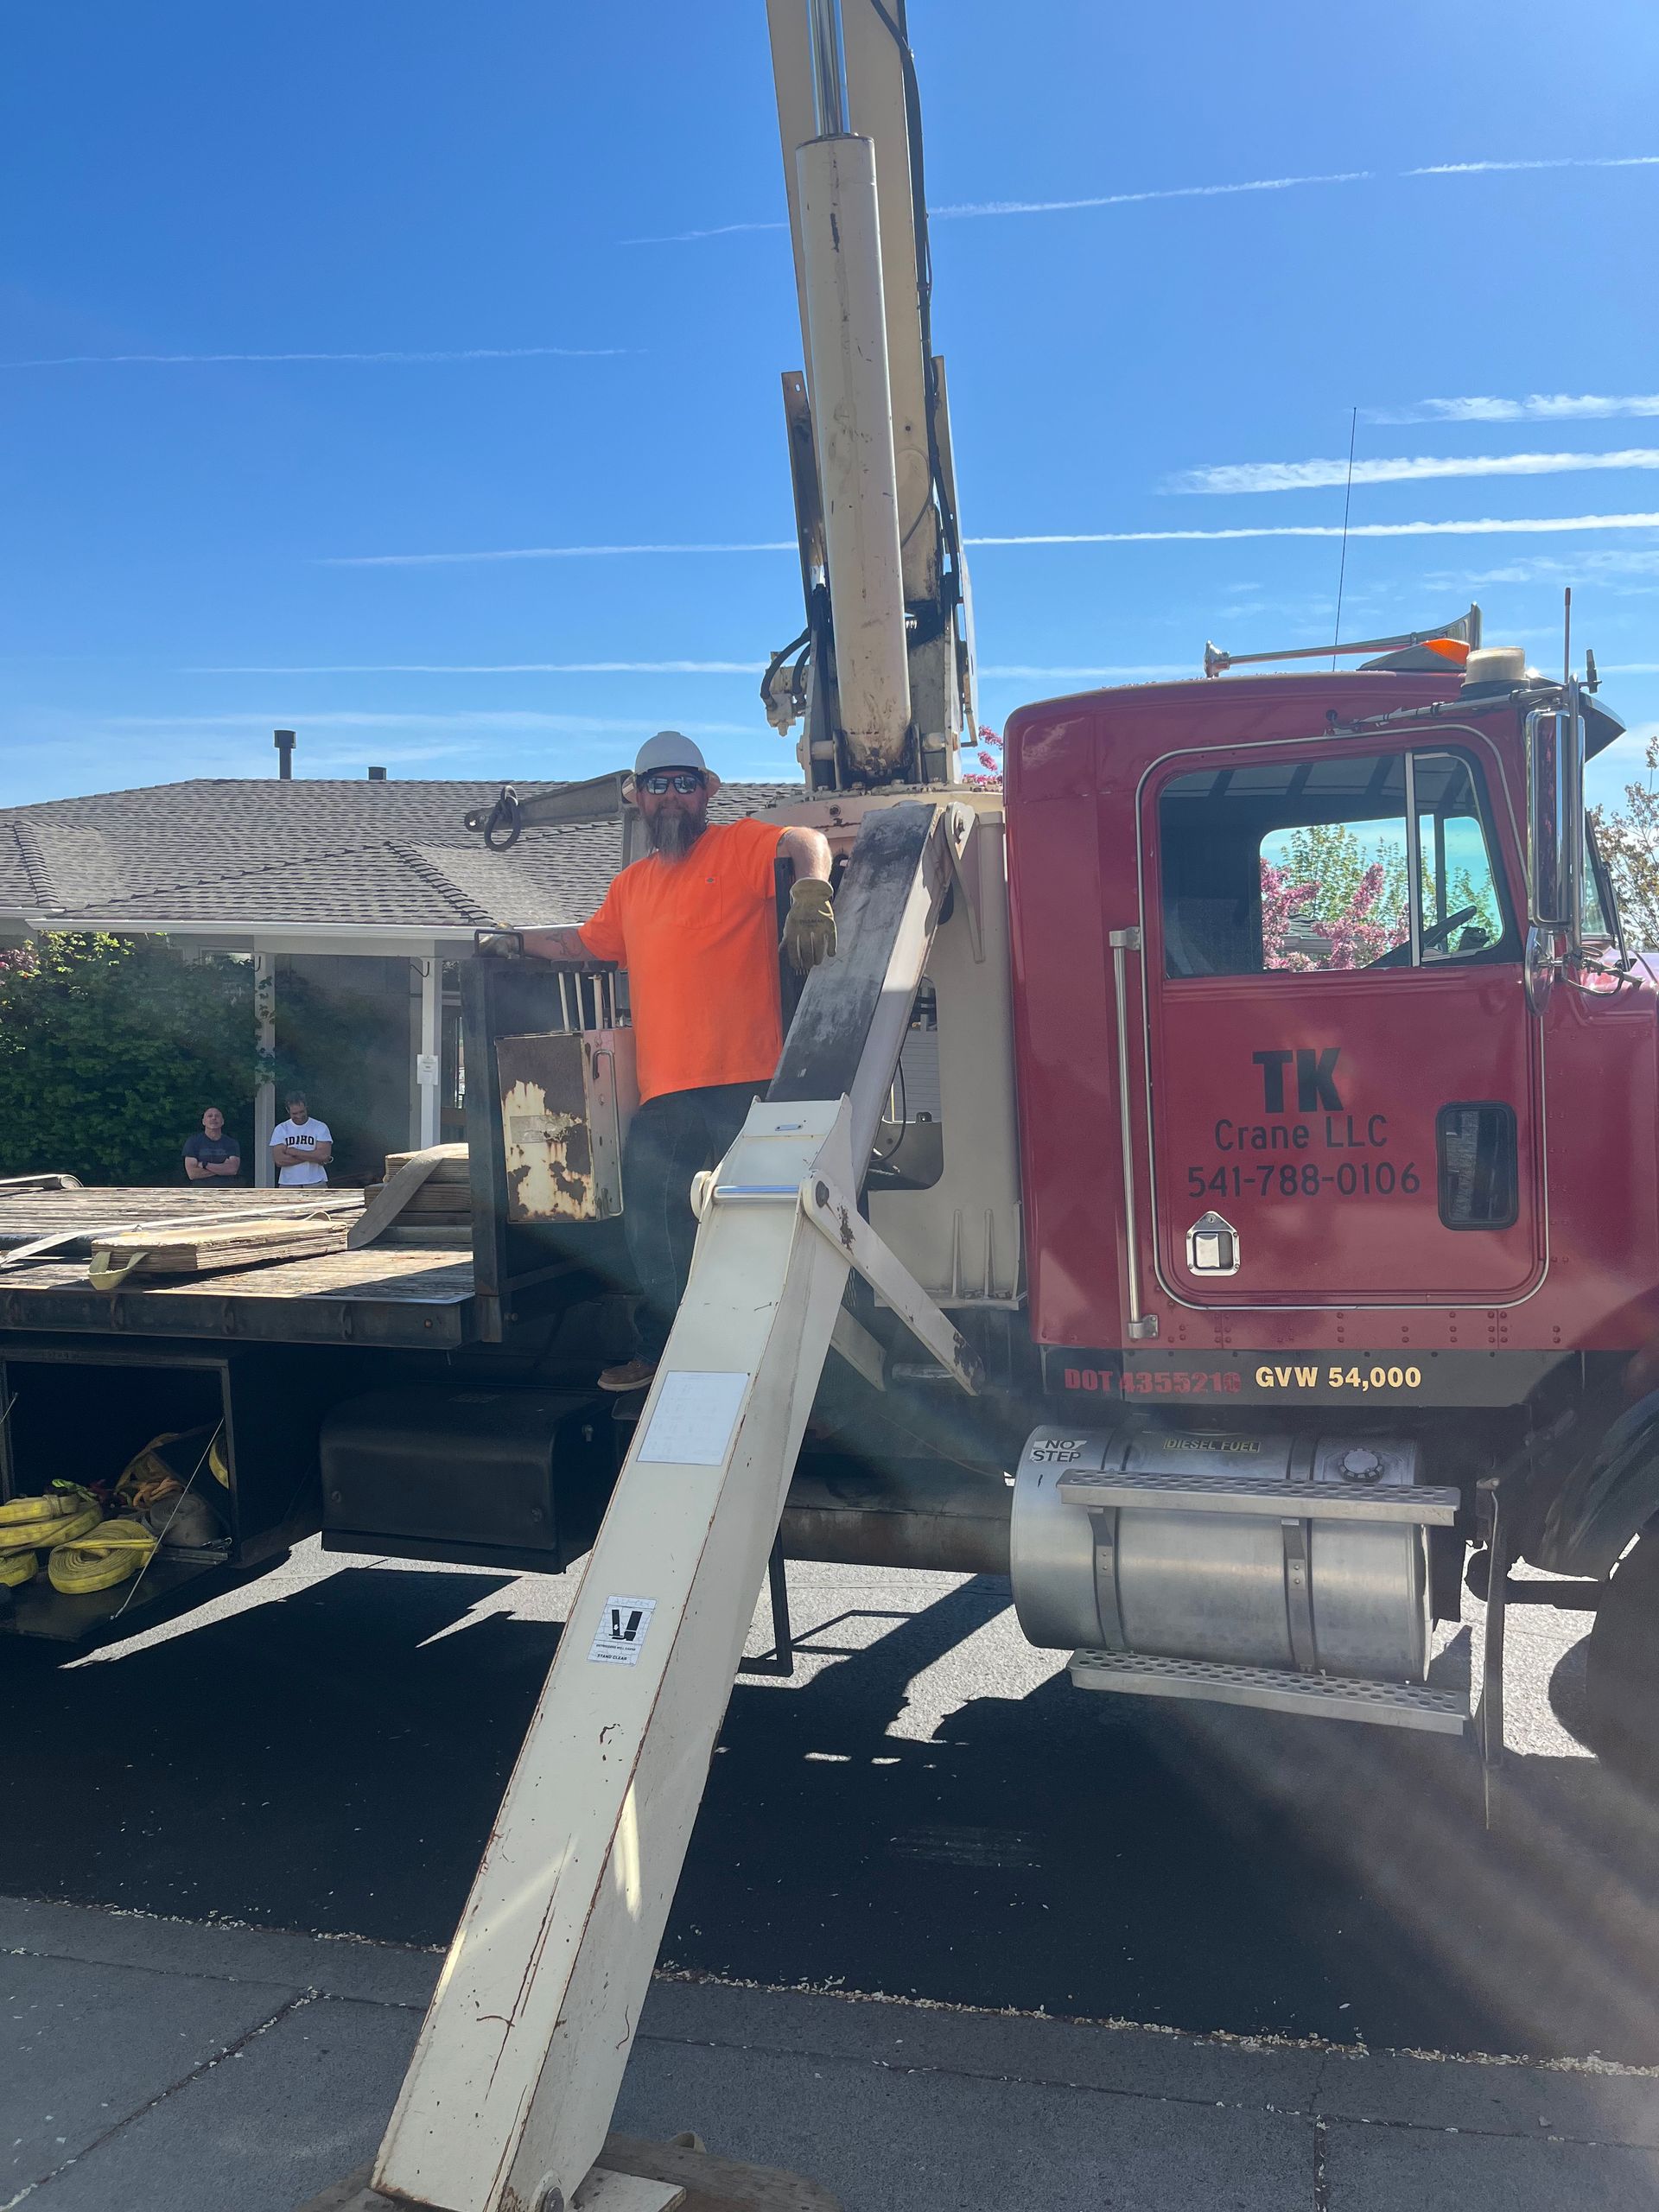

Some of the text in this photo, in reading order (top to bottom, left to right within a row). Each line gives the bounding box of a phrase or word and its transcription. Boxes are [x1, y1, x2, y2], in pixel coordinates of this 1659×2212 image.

[1252, 1047, 1344, 1113] TK
[1215, 1114, 1388, 1151] Crane LLC
[1188, 1162, 1421, 1198] 541-788-0106
[1064, 1368, 1113, 1391] DOT
[1255, 1366, 1421, 1392] GVW 54,000
[1033, 1450, 1082, 1463] STEP
[1045, 1439, 1076, 1450] NO
[1166, 1439, 1258, 1452] DIESEL FUEL
